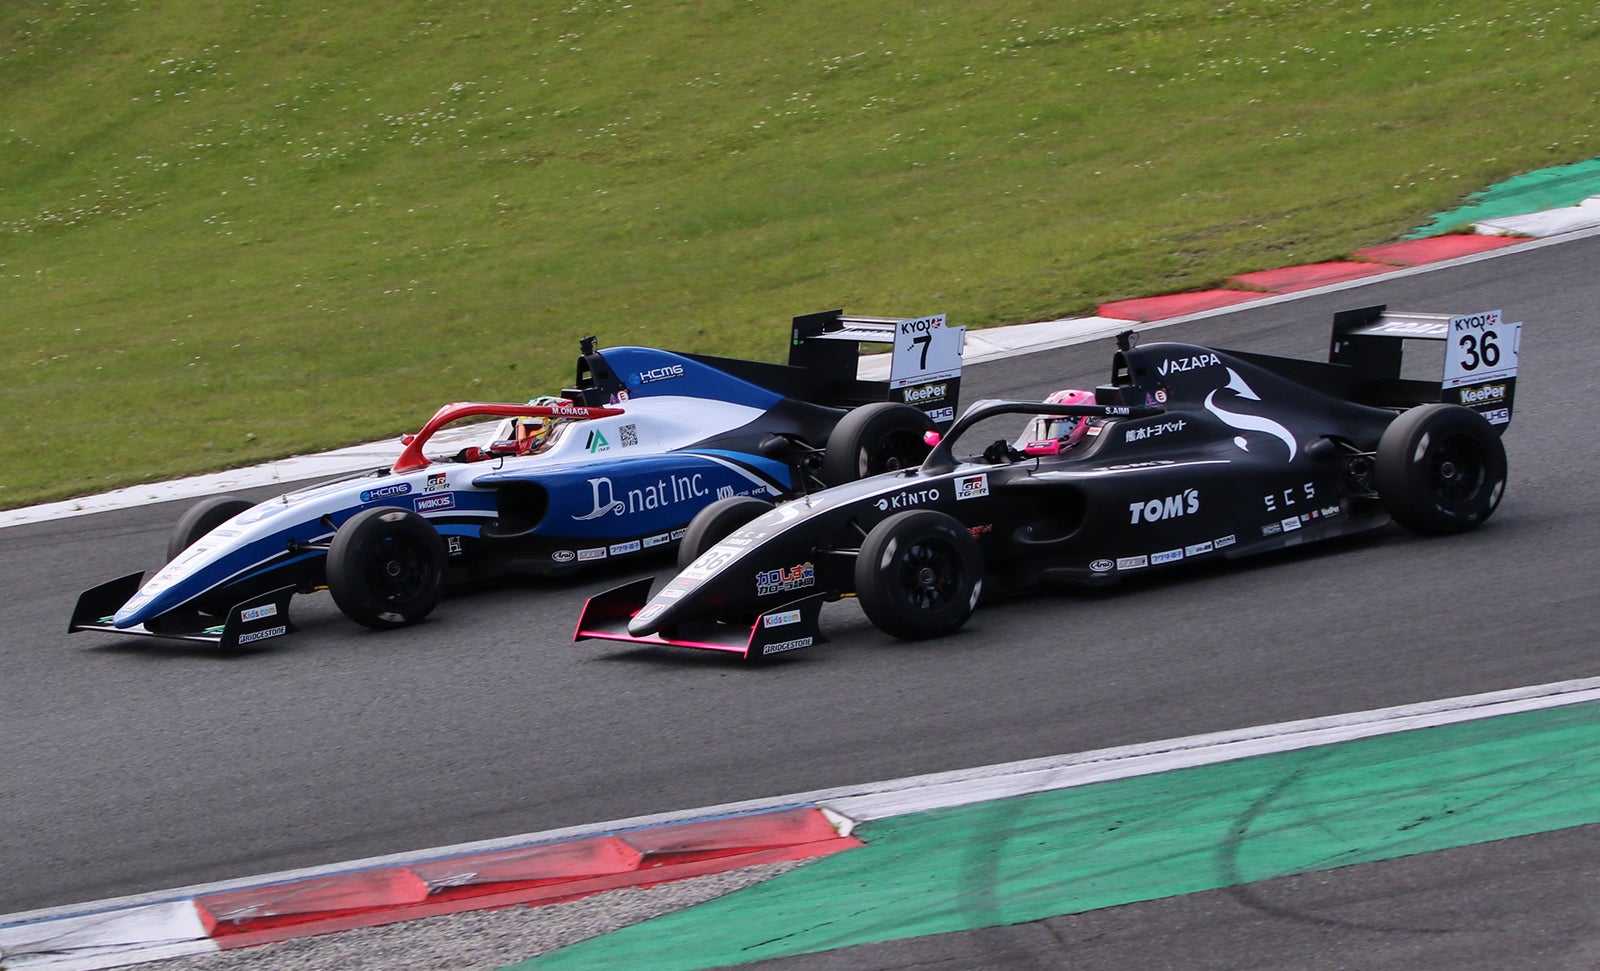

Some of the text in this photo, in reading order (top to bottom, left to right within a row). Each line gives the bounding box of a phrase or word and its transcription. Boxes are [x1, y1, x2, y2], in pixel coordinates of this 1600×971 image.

[913, 334, 932, 370] 7
[1459, 330, 1500, 371] 36
[552, 407, 590, 416] M.ONAGA
[670, 473, 709, 503] Inc.
[1129, 487, 1200, 524] TOM'S
[693, 551, 732, 571] 36
[239, 626, 286, 643] BRIDGESTONE
[763, 638, 812, 654] BRIDGESTONE
